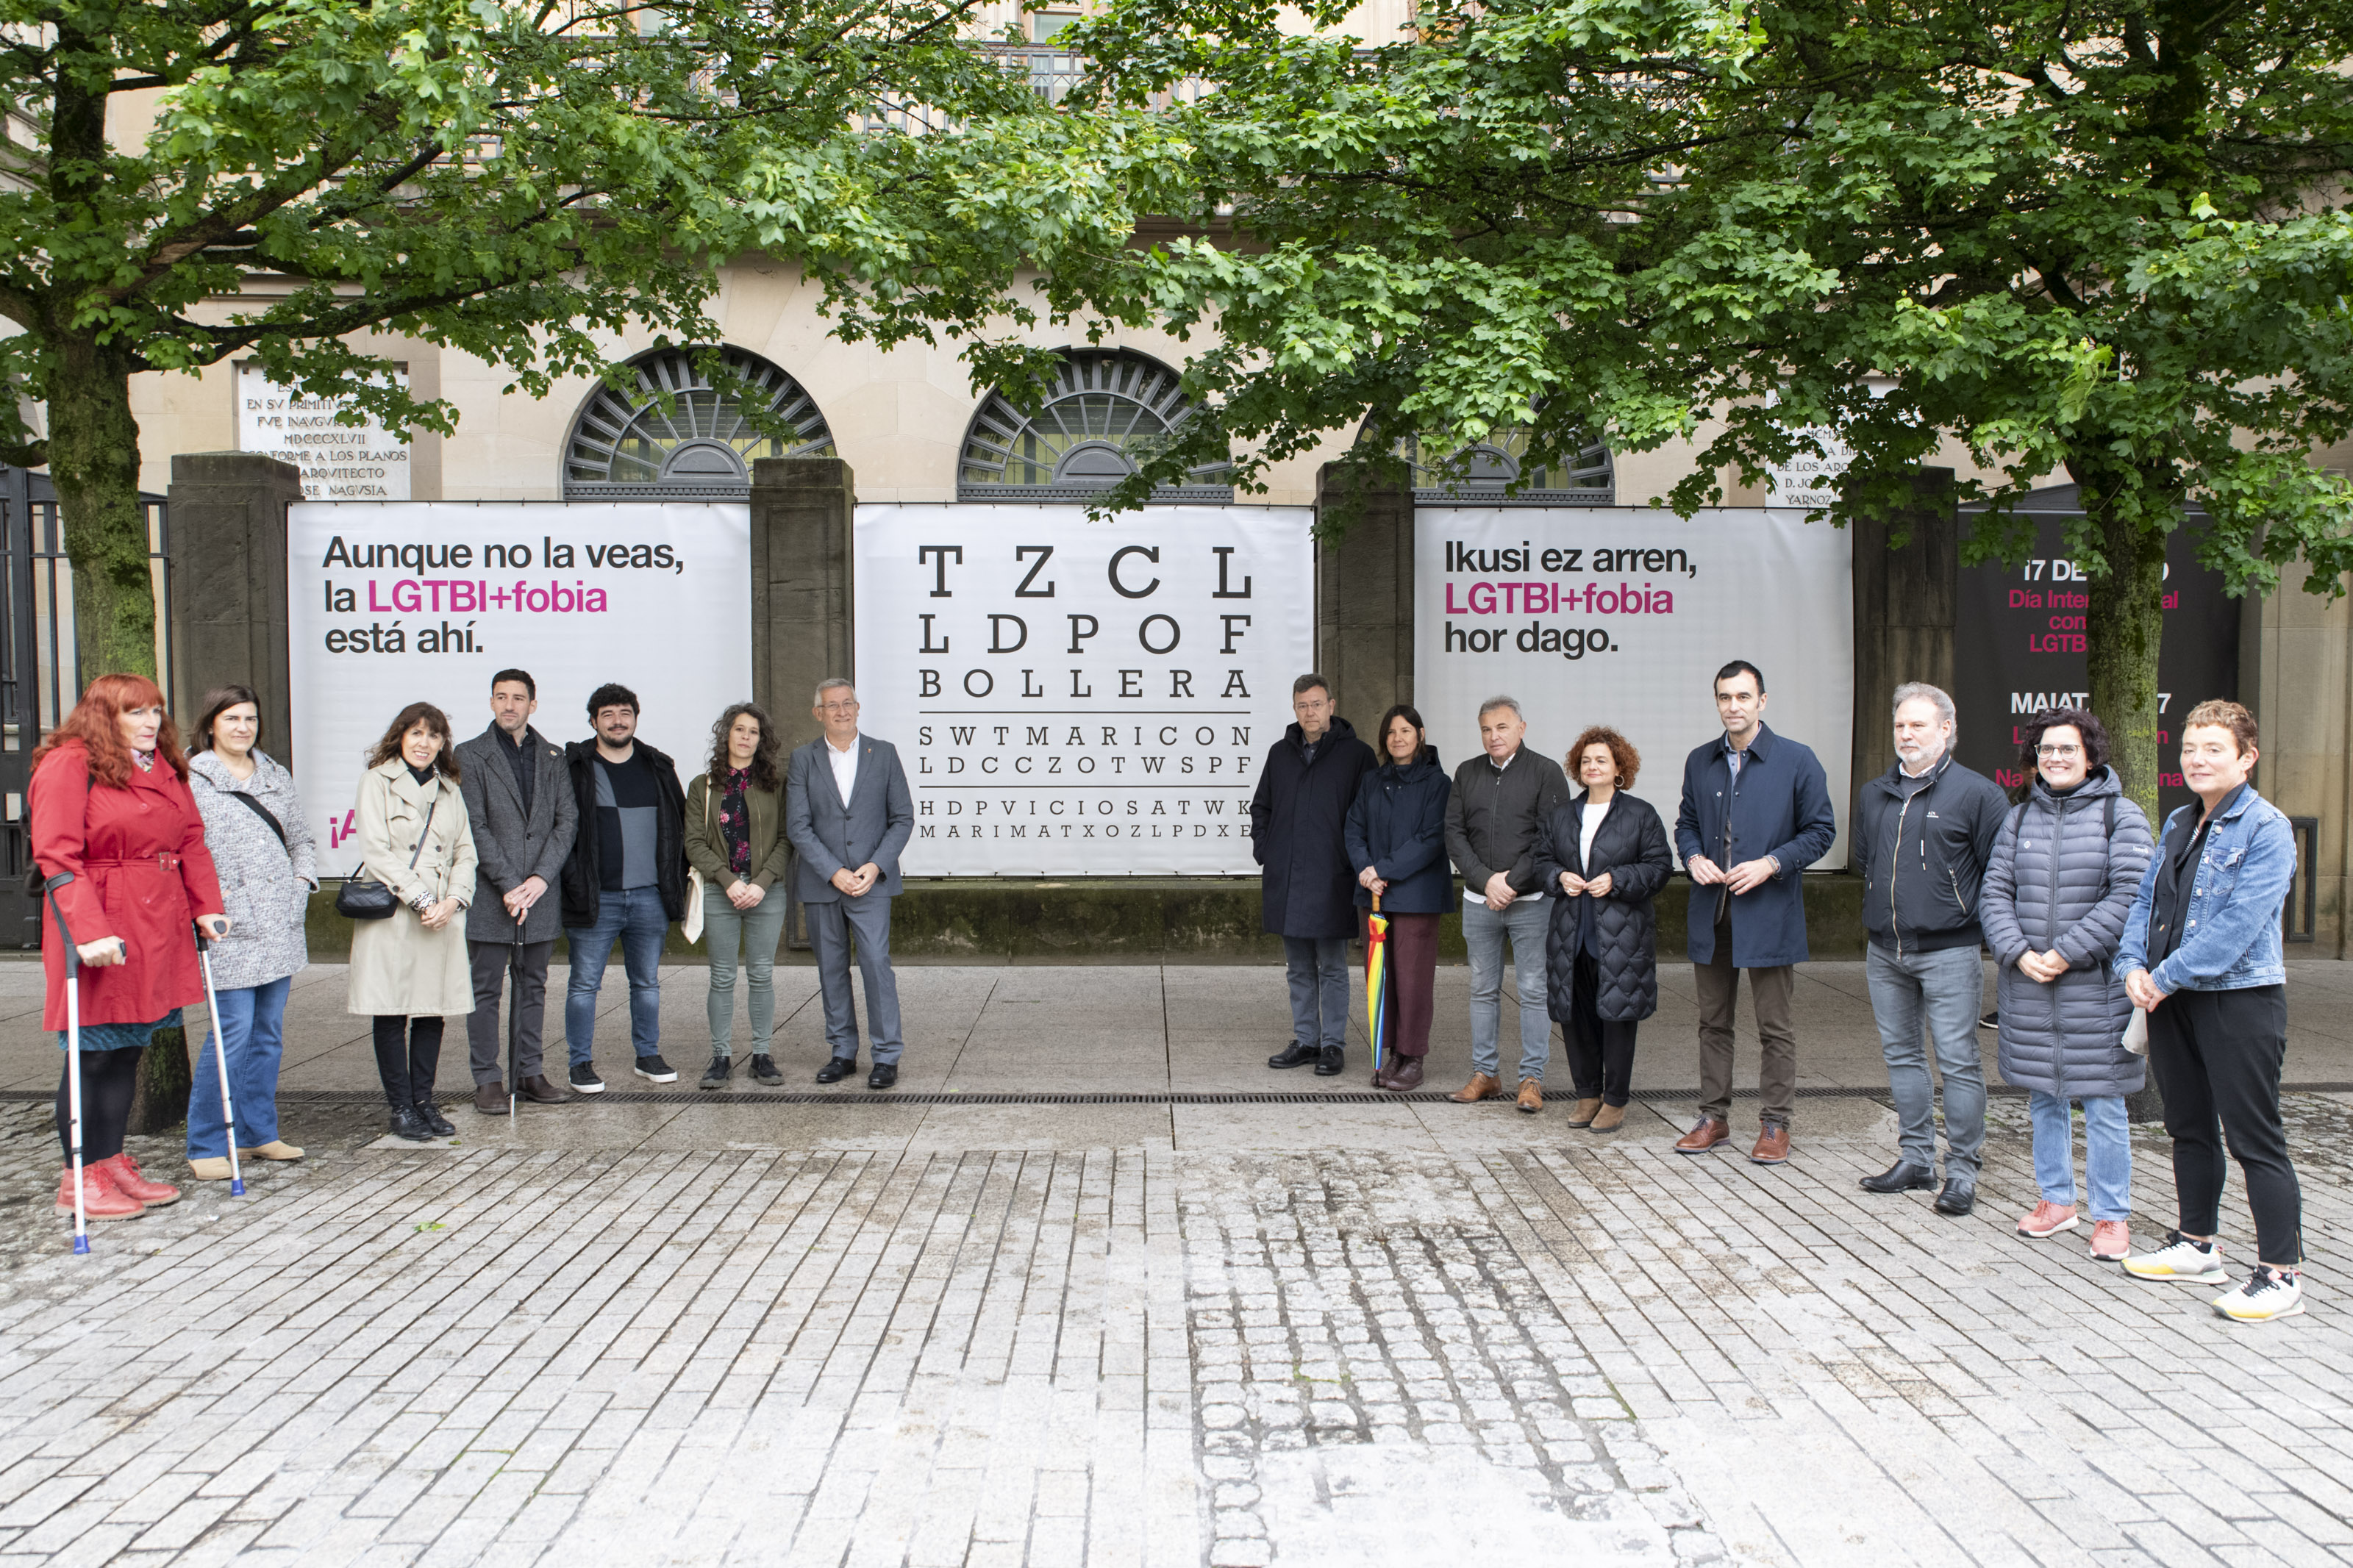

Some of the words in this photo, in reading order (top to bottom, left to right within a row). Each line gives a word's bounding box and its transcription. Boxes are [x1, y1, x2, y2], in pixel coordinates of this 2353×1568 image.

[247, 399, 262, 409] EN
[267, 399, 285, 409] SV
[257, 416, 282, 427] FVE
[284, 434, 365, 445] MDCCCXLVII
[249, 451, 310, 461] FORME
[315, 451, 326, 461] A
[330, 451, 354, 461] LOS
[358, 451, 407, 461] PLANOS
[300, 468, 385, 479] ARQVITECTO
[1796, 462, 1818, 472] LOS
[329, 485, 388, 495] NAGVSIA
[1785, 495, 1832, 505] YARNOZ
[323, 537, 473, 576] Aunque
[484, 544, 532, 568] no
[543, 536, 574, 569] la
[585, 544, 684, 576] veas,
[1446, 540, 1530, 573] Ikusi
[1540, 548, 1584, 573] ez
[1593, 548, 1697, 580] arren,
[2052, 559, 2088, 581] DE
[324, 579, 356, 612] la
[368, 579, 608, 612] LGTBI+fobia
[1446, 581, 1674, 615] LGTBI+fobia
[2009, 589, 2042, 608] Día
[324, 620, 406, 654] está
[417, 620, 484, 654] ahí.
[1445, 620, 1508, 654] hor
[1516, 620, 1618, 661] dago.
